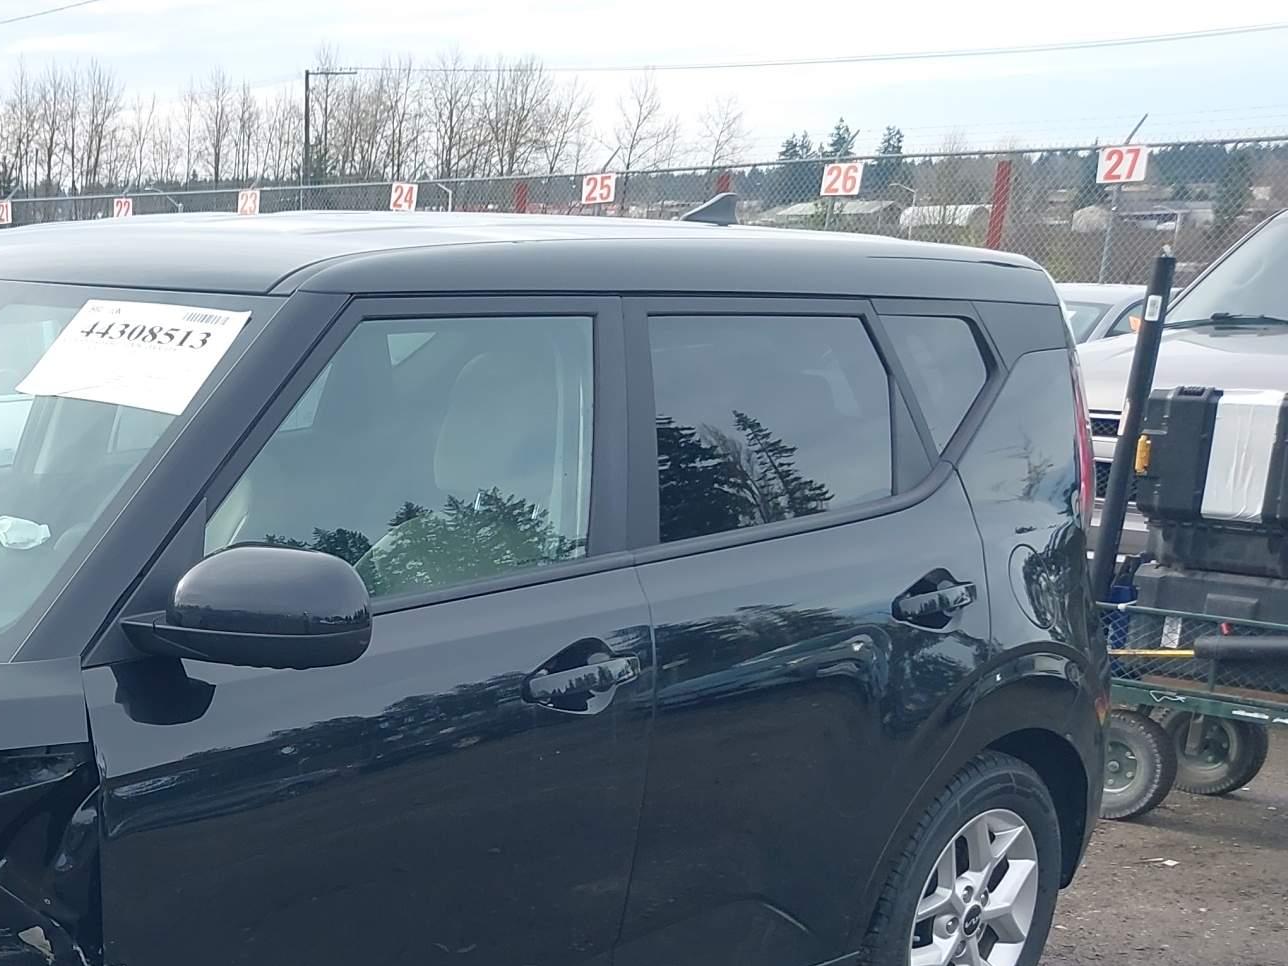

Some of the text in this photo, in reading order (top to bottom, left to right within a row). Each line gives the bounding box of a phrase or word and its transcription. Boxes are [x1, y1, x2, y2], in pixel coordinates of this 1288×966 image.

[1103, 149, 1141, 181] 27
[585, 175, 612, 201] 25
[824, 165, 857, 194] 26
[115, 200, 131, 217] 22
[240, 191, 258, 214] 23
[393, 184, 414, 209] 24
[80, 320, 212, 350] 44308513
